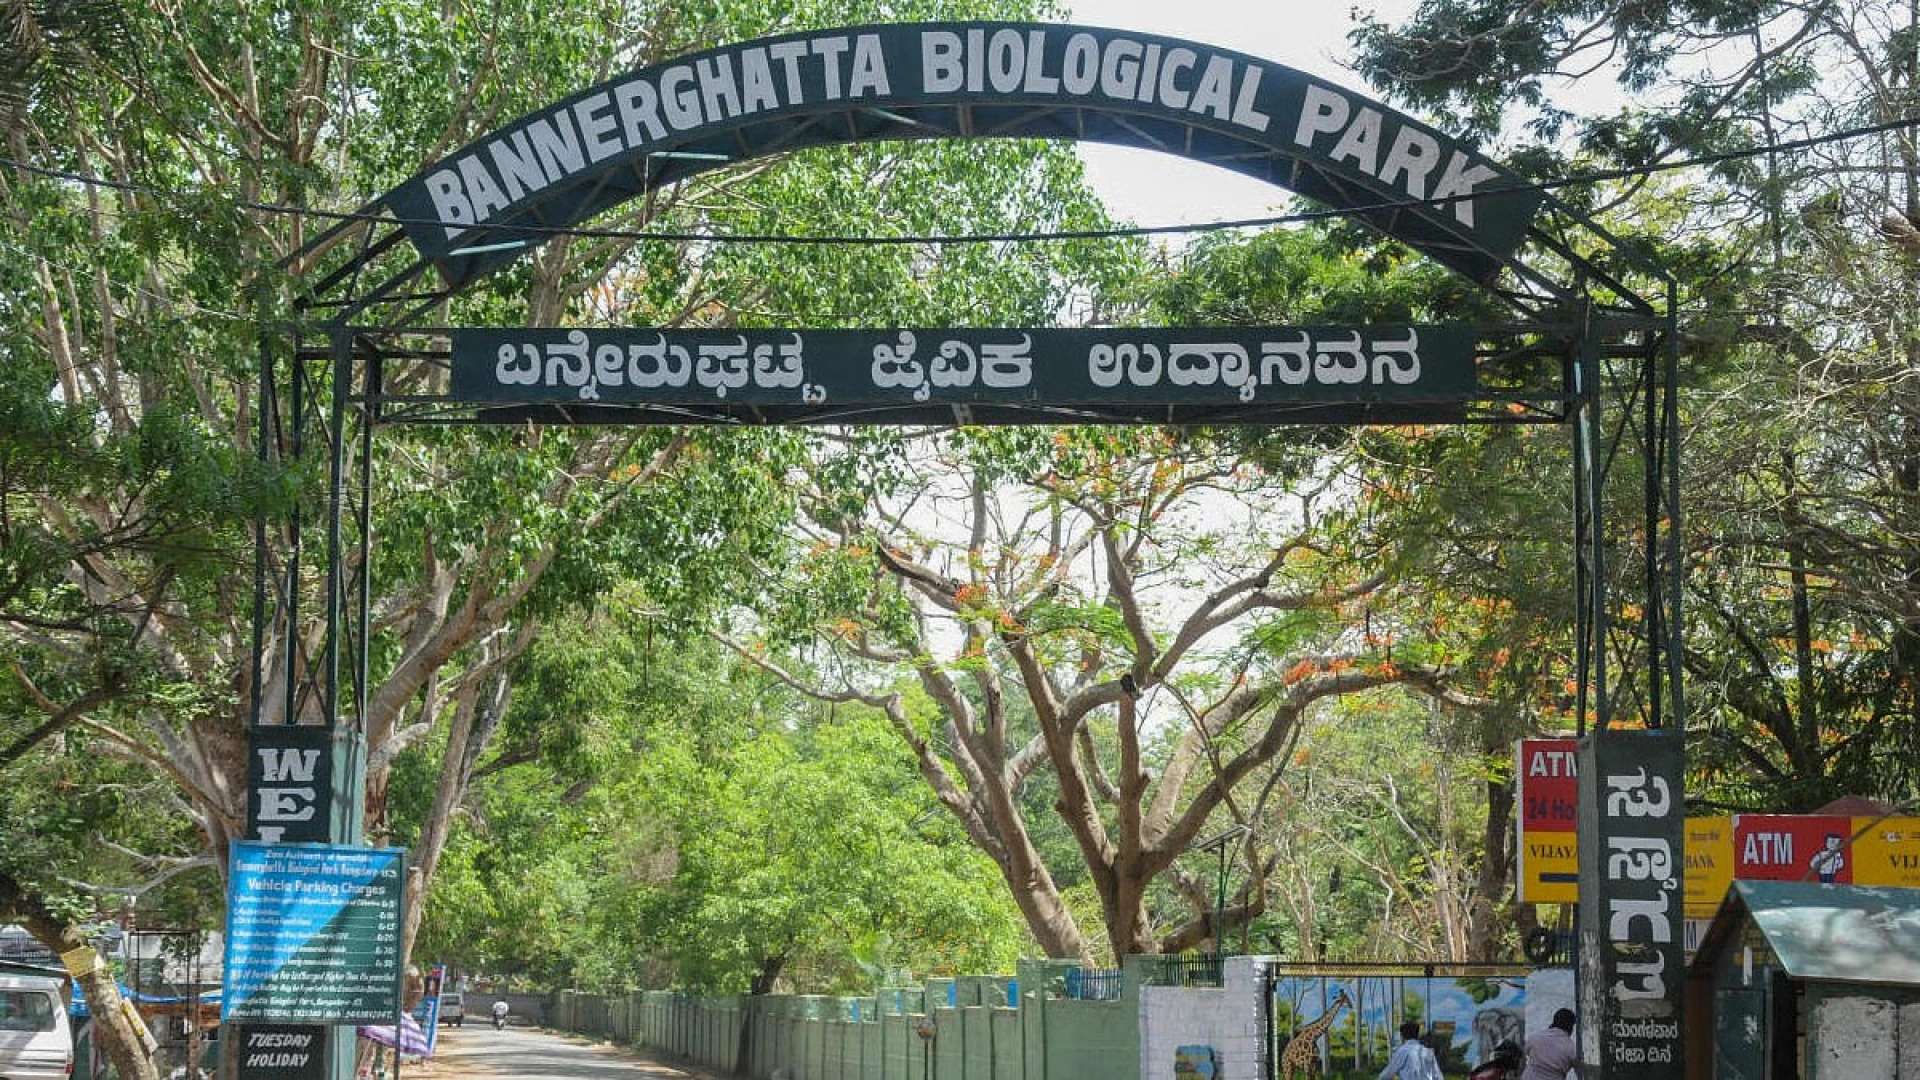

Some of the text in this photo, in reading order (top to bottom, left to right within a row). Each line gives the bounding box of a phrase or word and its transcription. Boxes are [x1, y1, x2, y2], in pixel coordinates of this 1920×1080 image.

[425, 28, 1501, 240] BANNERGHATTA BIOLOGICAL PARK
[495, 328, 1421, 404] ಬನ್ನೇರುಘಟ್ಟ ಜೈವಿಕ ಉದ್ಯಾನವನ
[1530, 844, 1577, 859] VIJAY
[1743, 832, 1793, 865] ATM
[247, 878, 386, 897] Vehicle Parking Charges
[247, 1033, 313, 1047] TUESDAY
[246, 1053, 310, 1067] HOLIDAY
